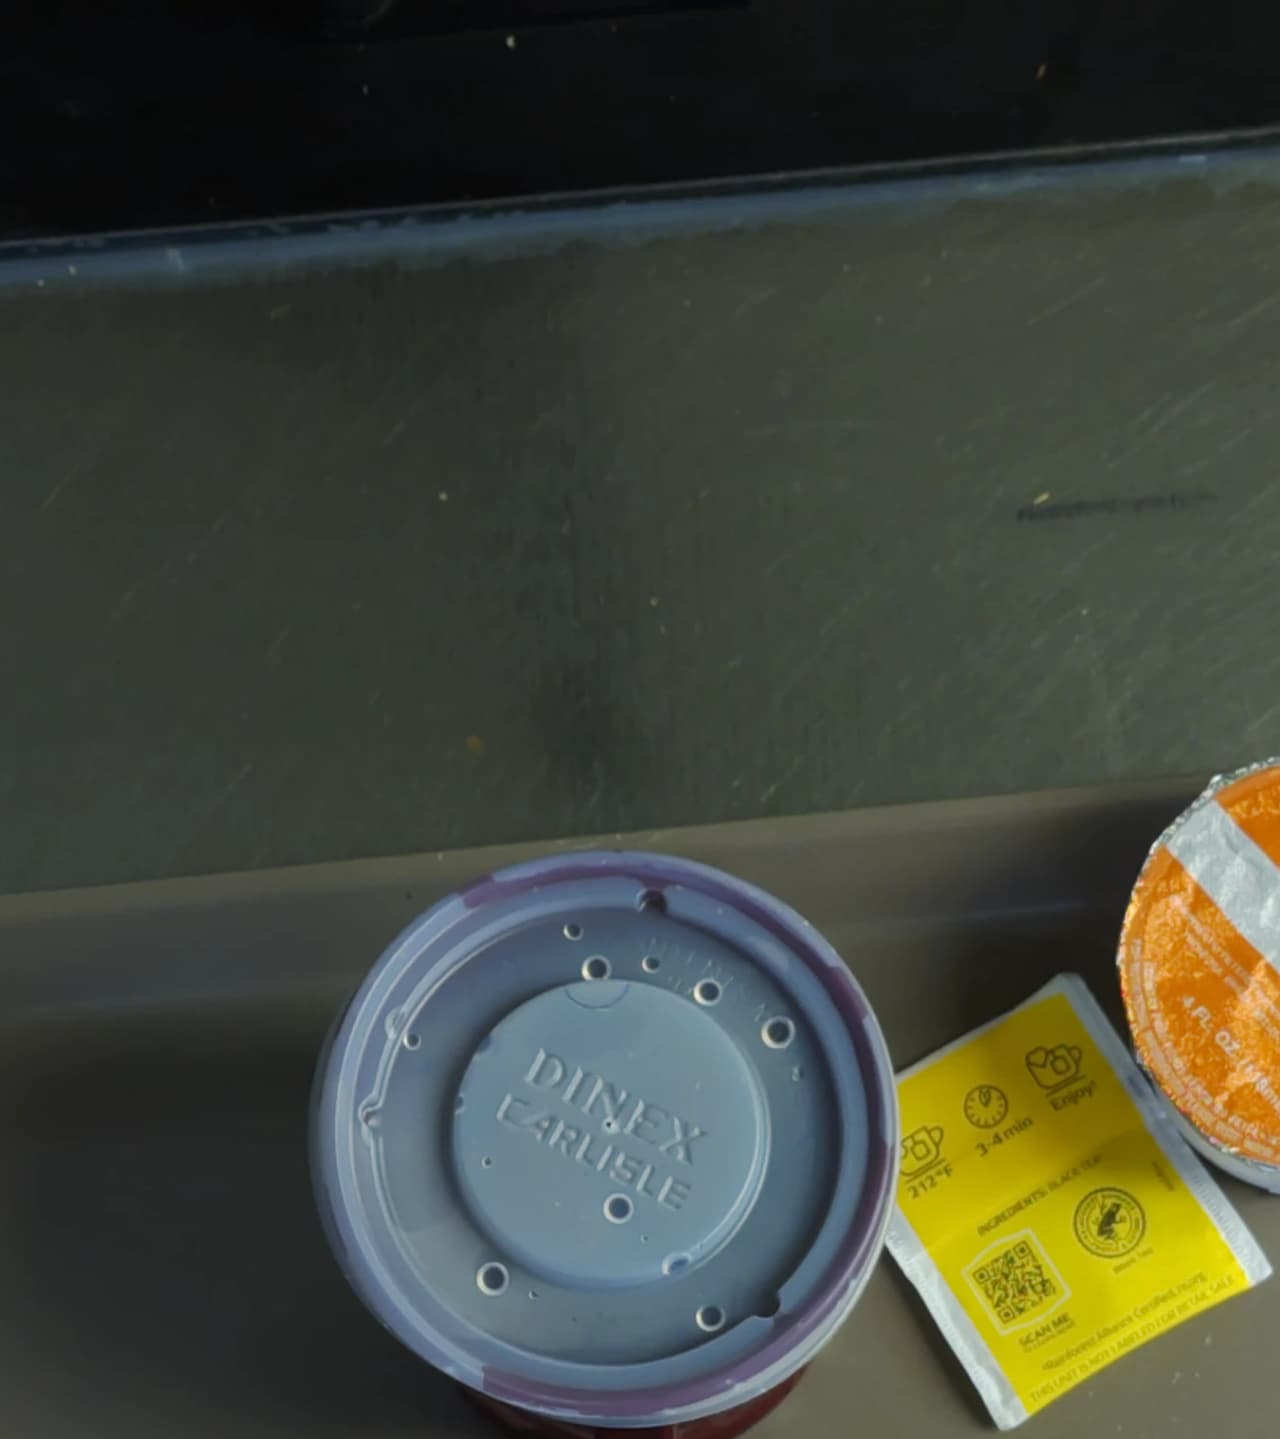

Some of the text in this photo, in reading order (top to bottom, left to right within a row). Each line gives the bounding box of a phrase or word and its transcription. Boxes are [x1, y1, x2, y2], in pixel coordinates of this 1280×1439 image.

[1211, 1028, 1240, 1057] OZ
[523, 1049, 707, 1165] DINEX
[494, 1094, 691, 1210] CARLISLE
[975, 1115, 1033, 1156] 3-4 min
[907, 1163, 954, 1198] 212°F
[1018, 1323, 1052, 1348] SCAN
[1051, 1312, 1070, 1328] ME
